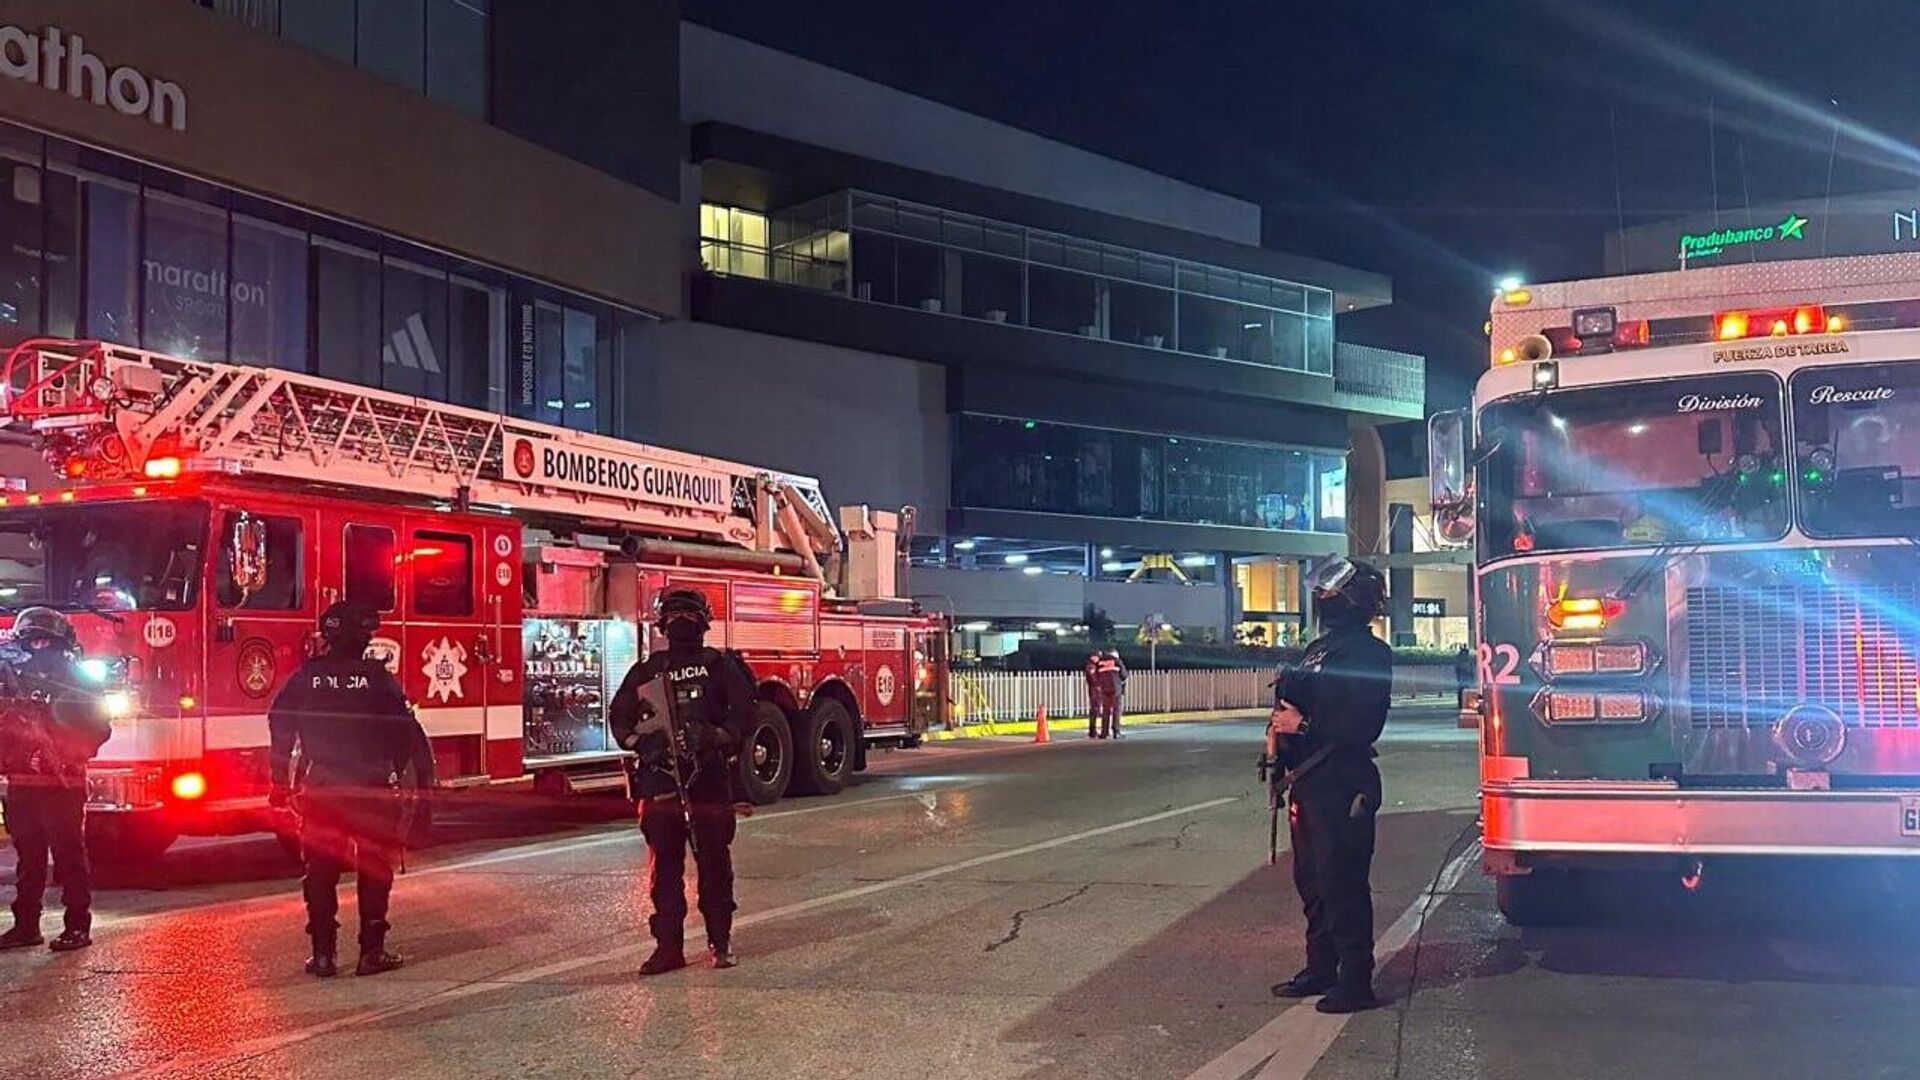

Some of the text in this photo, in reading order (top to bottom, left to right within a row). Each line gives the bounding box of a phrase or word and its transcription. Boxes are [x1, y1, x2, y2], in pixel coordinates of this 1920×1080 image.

[0, 26, 187, 132] athon
[1681, 226, 1774, 249] Produbanco
[1713, 341, 1849, 362] FUERZA DE TAREA
[1677, 393, 1763, 413] División
[1809, 385, 1895, 405] Rescate
[543, 447, 725, 505] BOMBEROS GUAYAQUIL
[655, 666, 709, 681] OLICIA
[1477, 642, 1521, 685] R2
